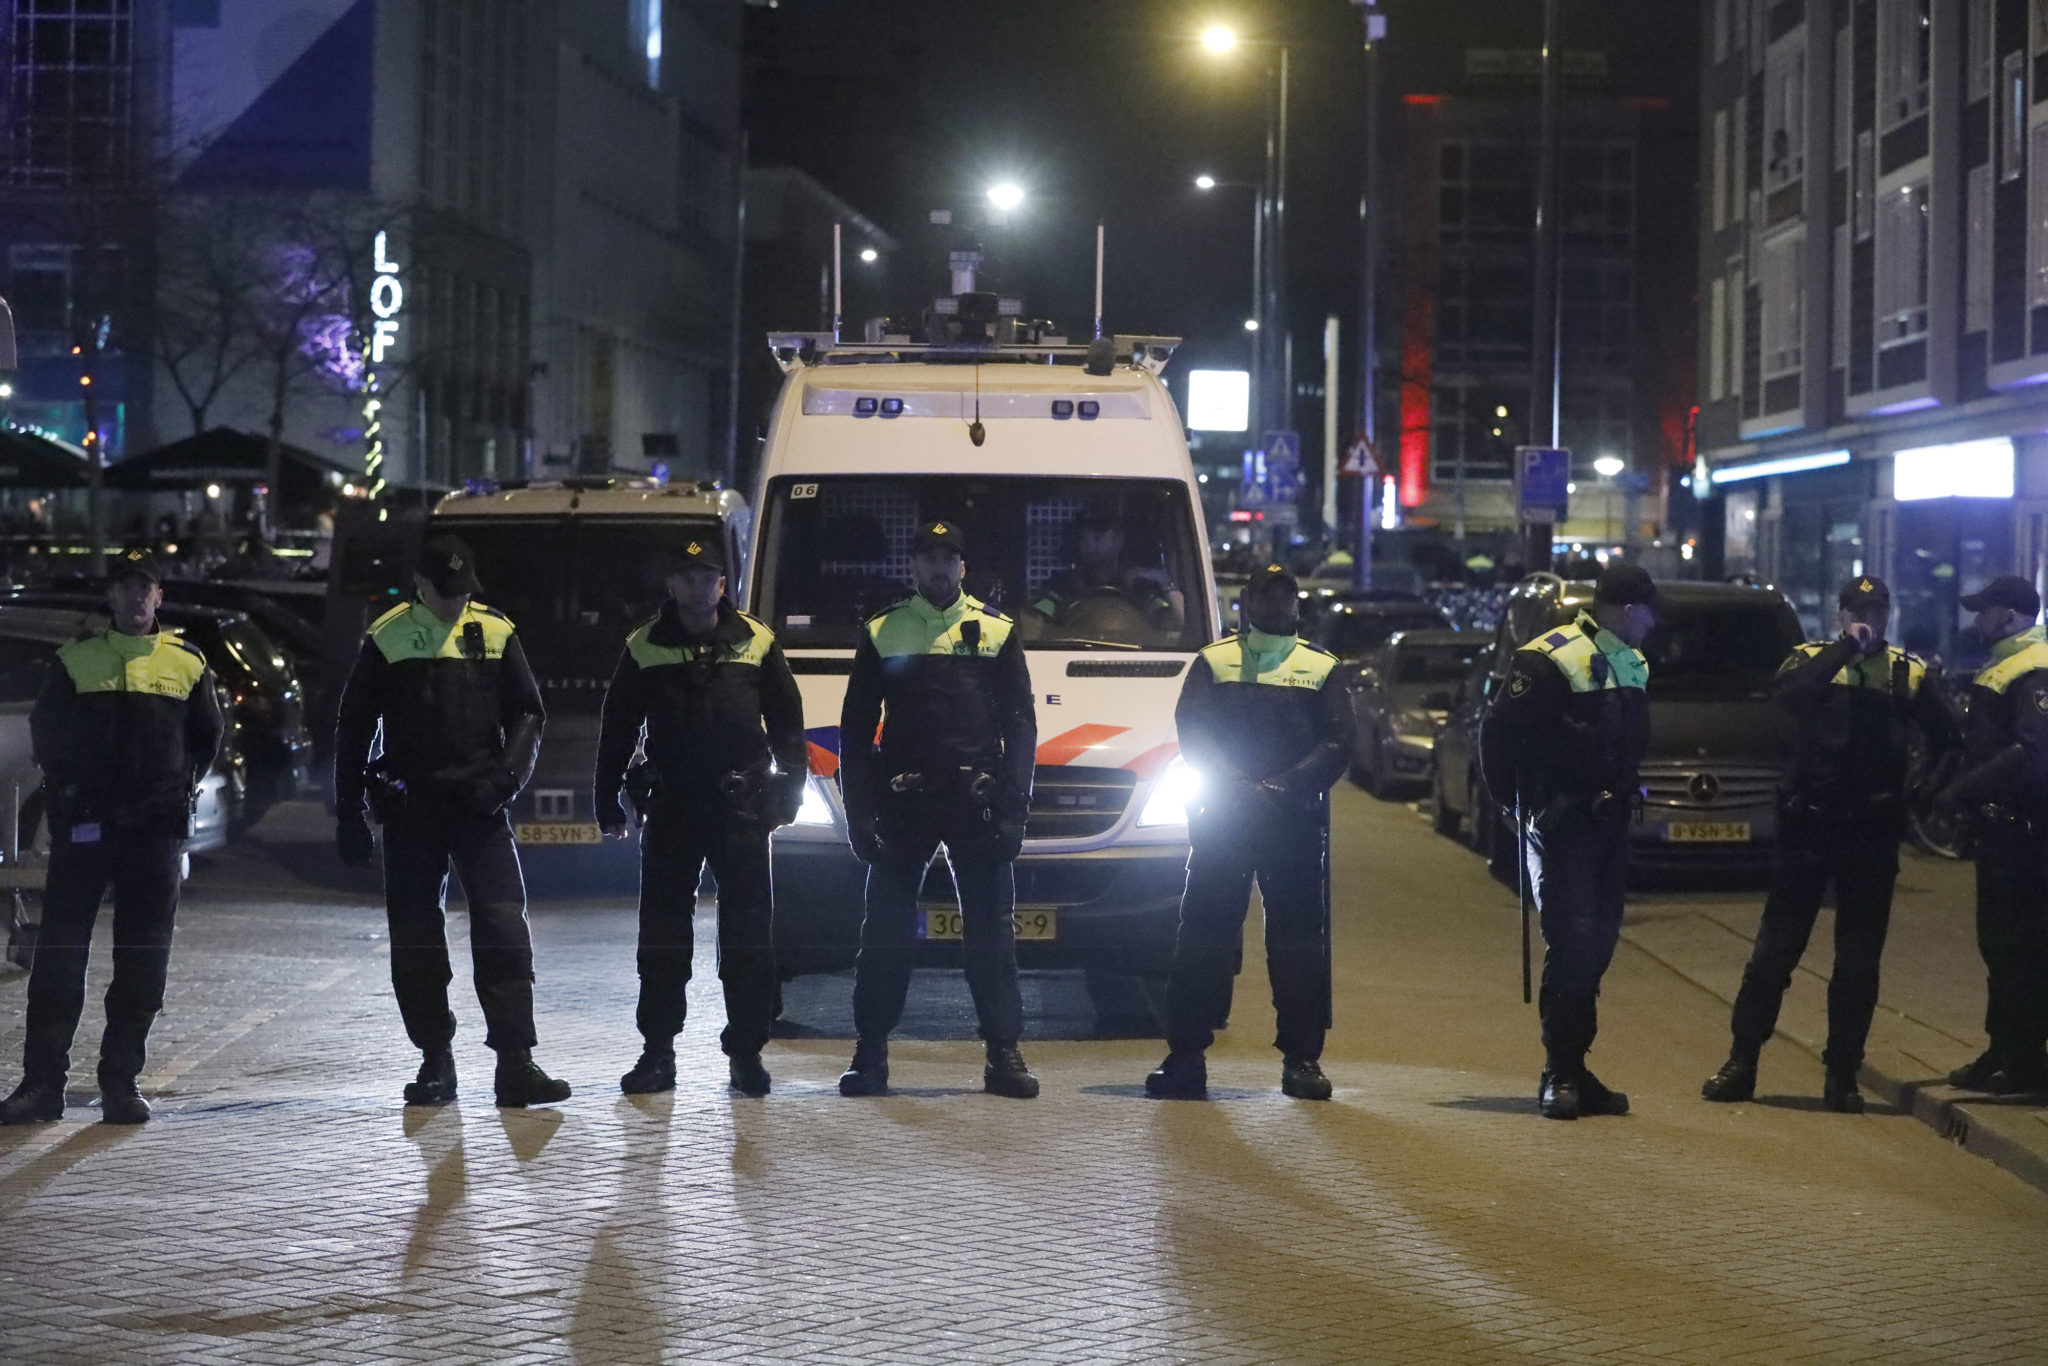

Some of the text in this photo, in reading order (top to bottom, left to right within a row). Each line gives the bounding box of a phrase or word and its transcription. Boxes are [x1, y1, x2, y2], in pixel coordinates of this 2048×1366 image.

[1525, 452, 1541, 475] P
[794, 486, 815, 496] 06
[522, 828, 597, 841] 58-SVN-3
